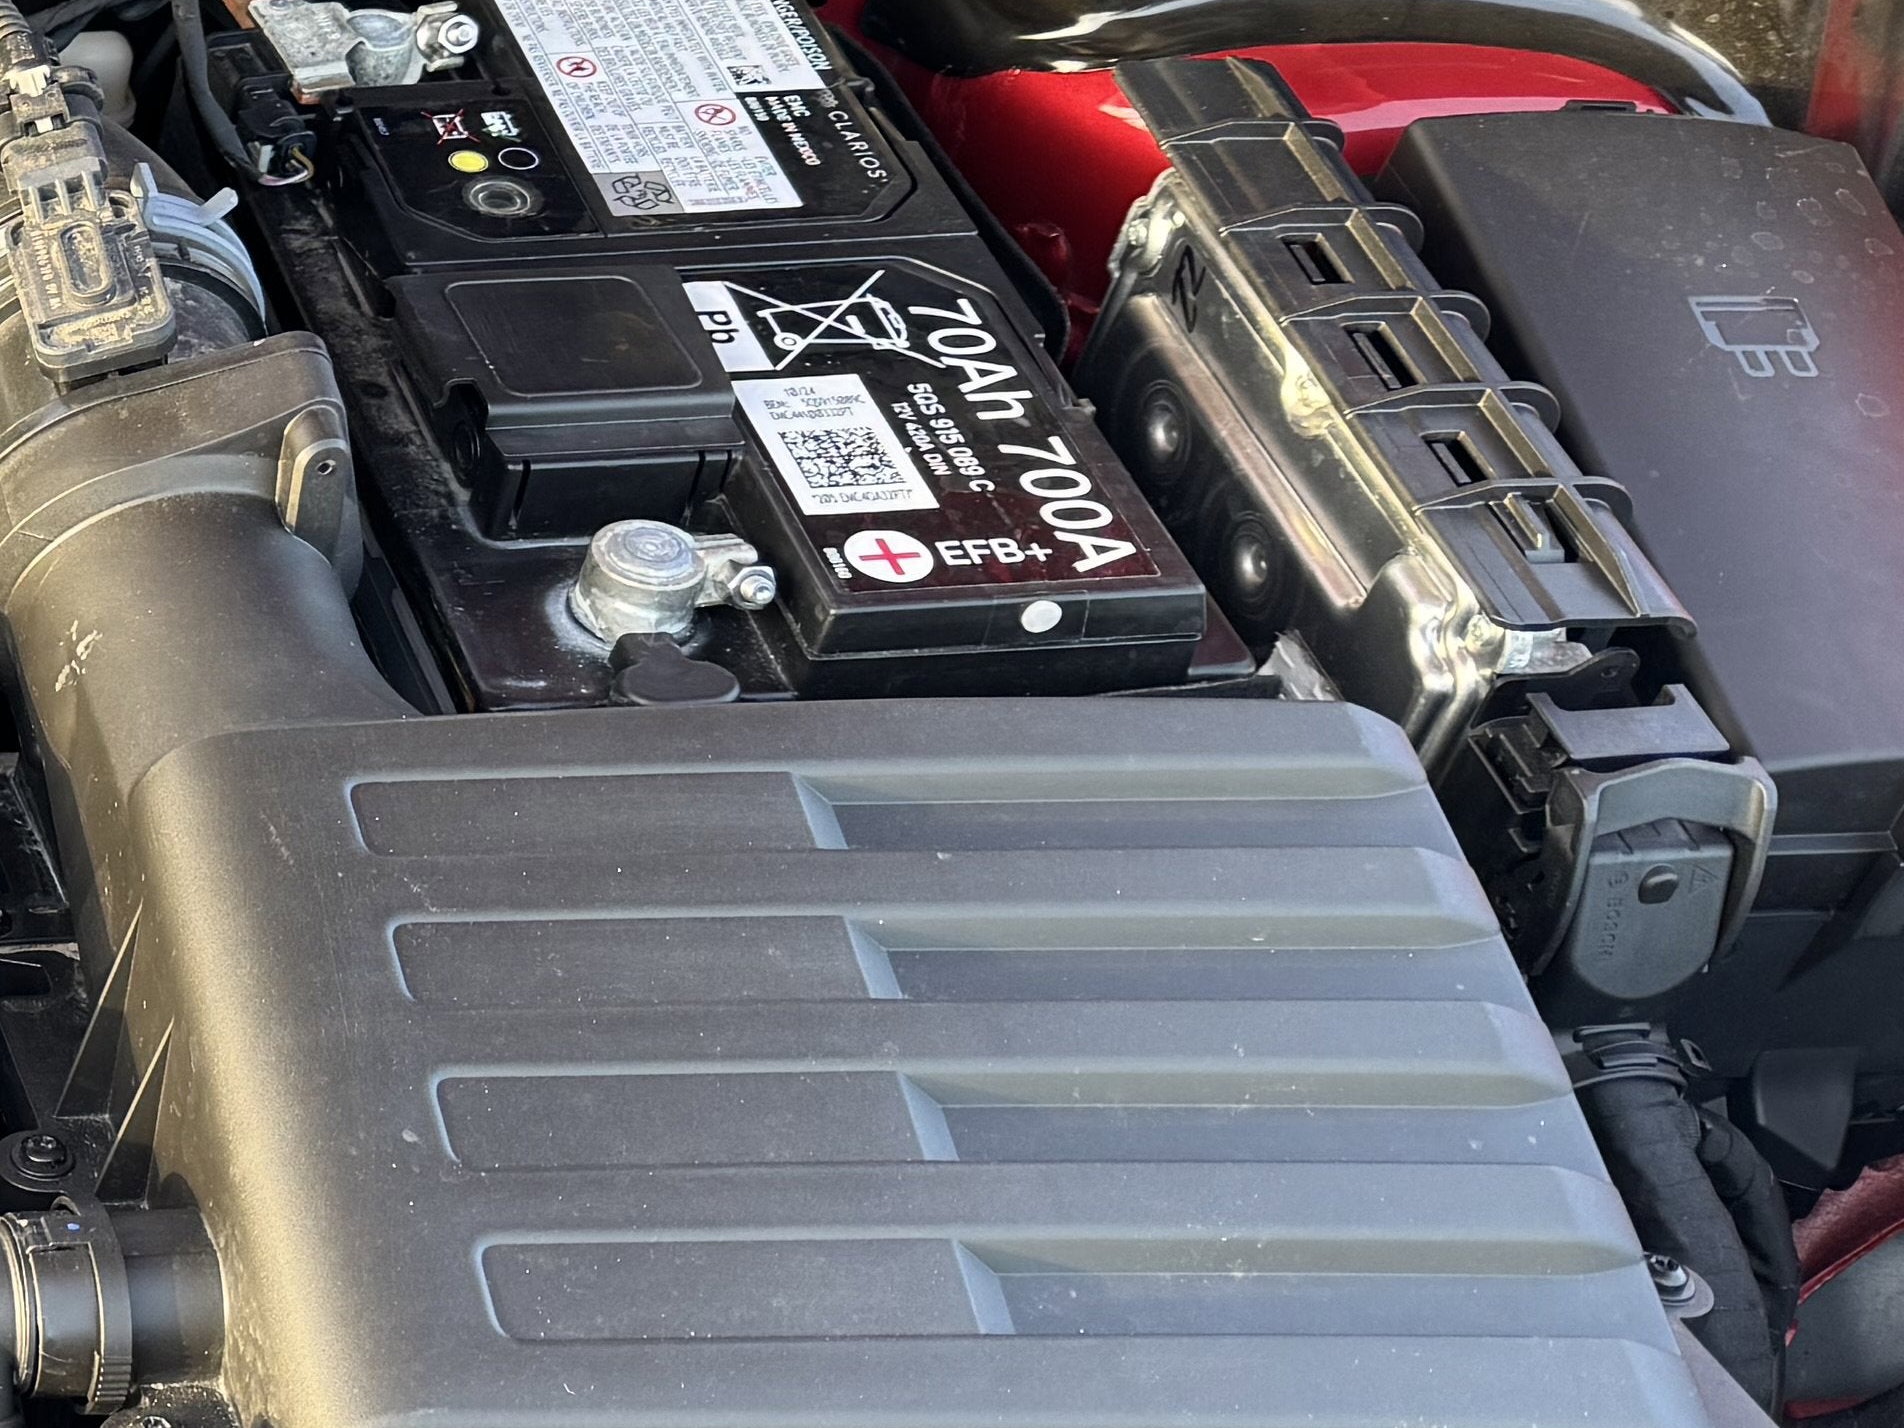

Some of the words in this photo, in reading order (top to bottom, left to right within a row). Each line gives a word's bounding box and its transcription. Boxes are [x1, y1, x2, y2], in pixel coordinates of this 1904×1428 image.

[783, 95, 811, 117] EMC
[764, 96, 792, 121] MADE
[788, 133, 822, 166] MEXICO
[828, 109, 886, 180] CLARIOS
[696, 309, 735, 345] Pb
[891, 402, 917, 420] 12V
[905, 422, 935, 451] 420A
[923, 453, 952, 476] DIN
[908, 298, 1034, 421] 70Ah
[998, 435, 1137, 573] 700A
[929, 418, 966, 444] 915
[947, 447, 986, 476] 089
[968, 479, 996, 492] C
[934, 537, 1053, 568] EFB+
